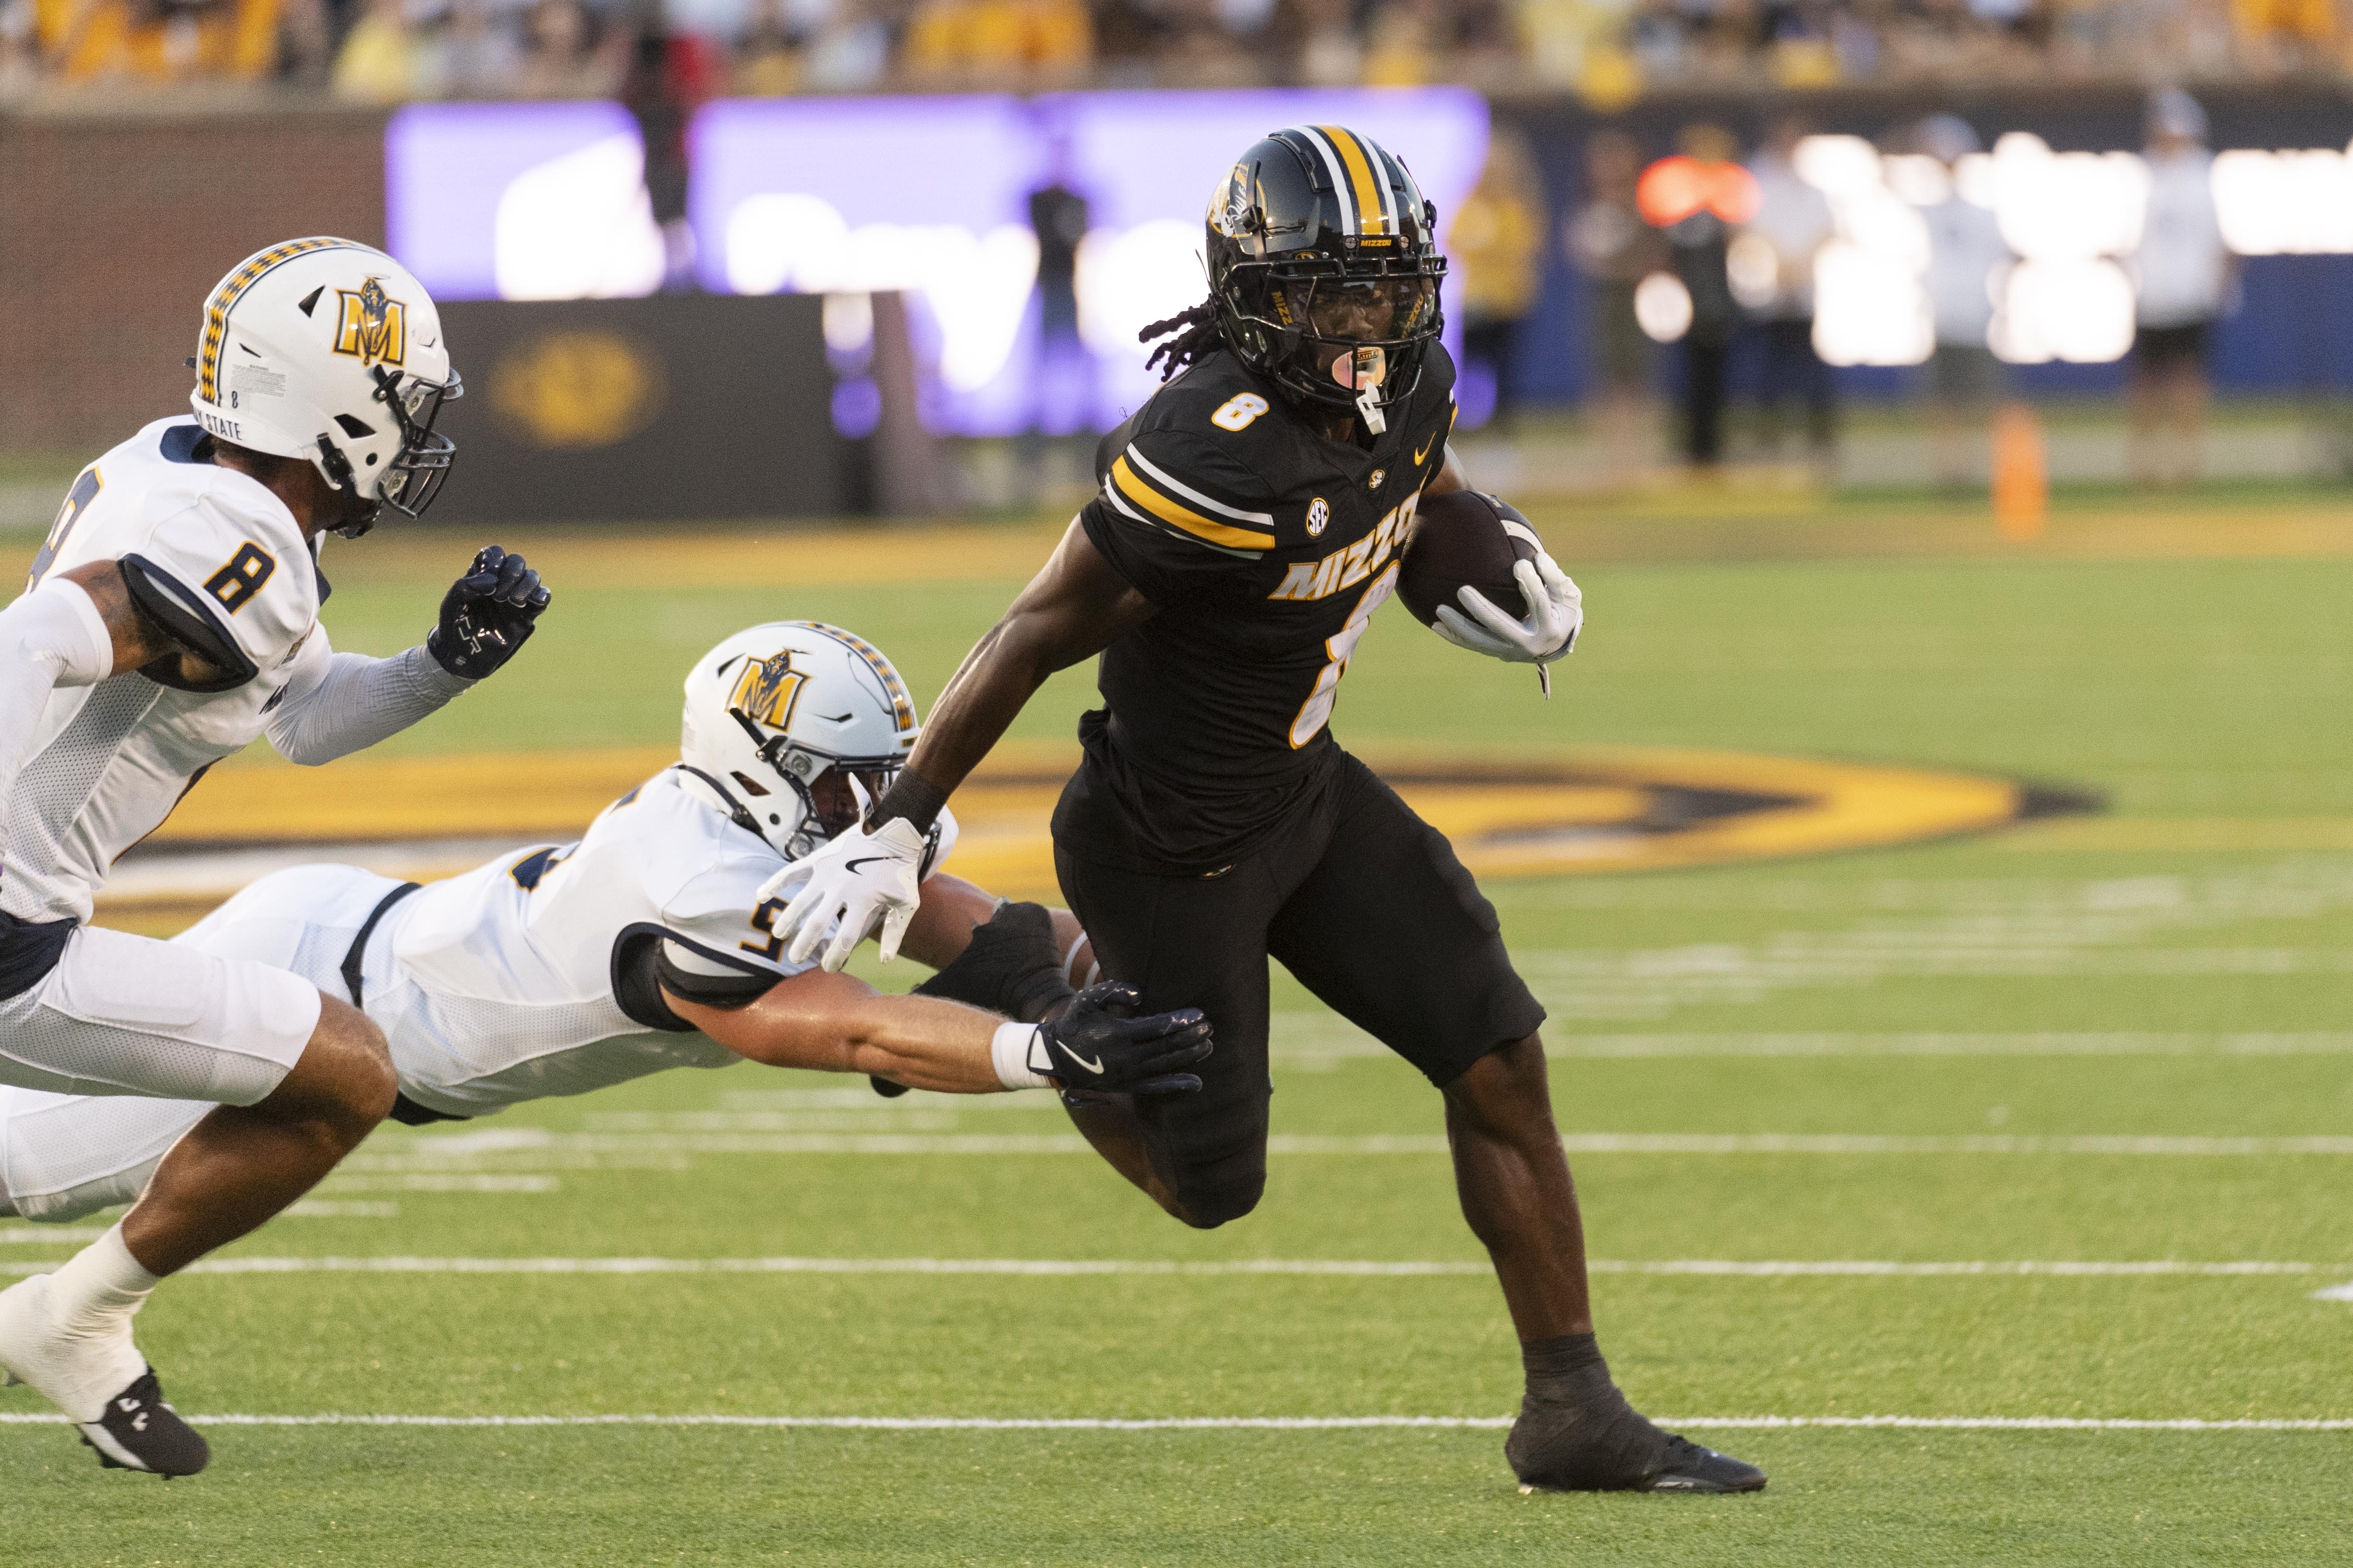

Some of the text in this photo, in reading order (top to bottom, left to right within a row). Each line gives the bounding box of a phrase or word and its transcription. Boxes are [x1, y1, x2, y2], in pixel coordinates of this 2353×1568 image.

[1271, 291, 1293, 325] MIZZ
[1357, 351, 1377, 359] ATTLE
[232, 391, 238, 408] 8
[1211, 393, 1269, 432] 8
[206, 413, 242, 440] STATE
[1267, 464, 1432, 600] MIZZO
[1308, 500, 1328, 534] SEC
[202, 540, 277, 617] 8
